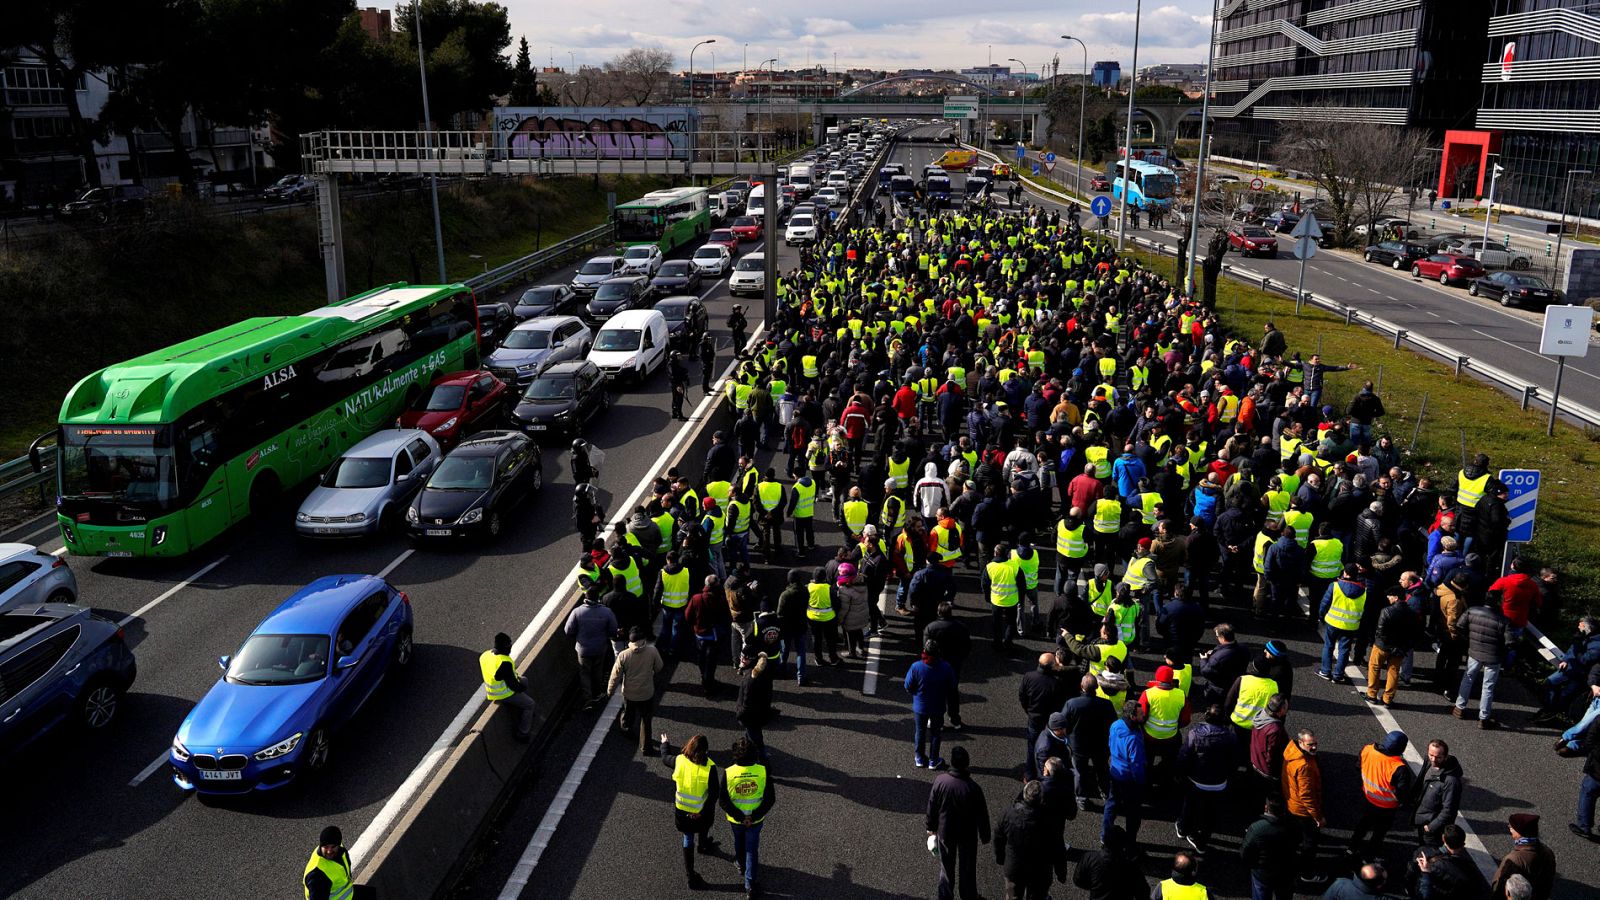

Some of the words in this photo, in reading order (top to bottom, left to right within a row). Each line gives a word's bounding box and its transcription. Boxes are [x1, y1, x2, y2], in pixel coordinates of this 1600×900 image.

[263, 365, 297, 390] ALSA
[259, 444, 277, 458] ALSA
[1504, 474, 1535, 485] 200
[205, 771, 222, 779] 4141
